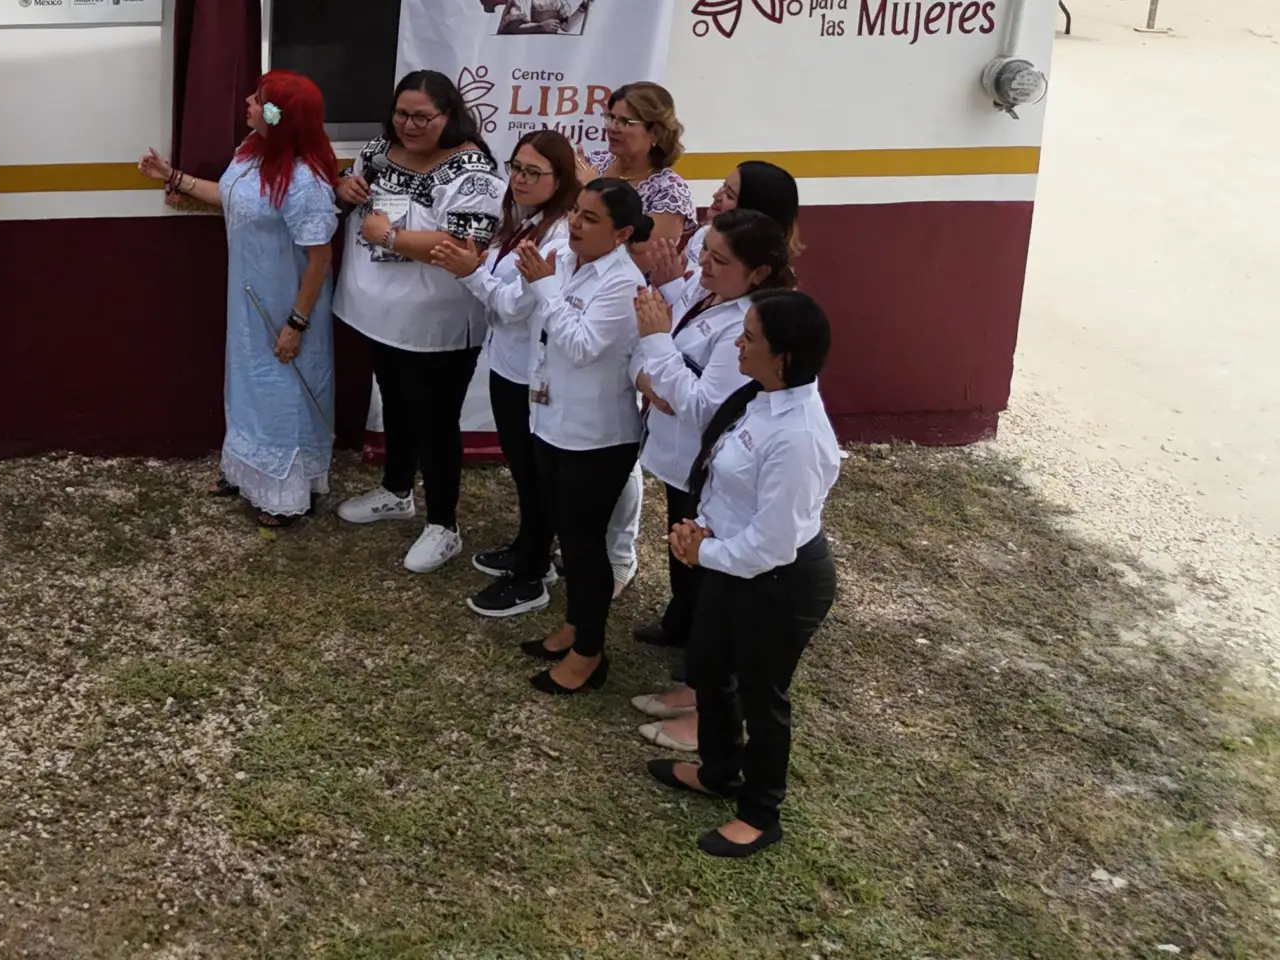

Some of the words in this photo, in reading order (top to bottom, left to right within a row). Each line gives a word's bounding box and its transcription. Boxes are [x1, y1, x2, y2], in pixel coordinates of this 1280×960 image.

[820, 14, 845, 36] las
[511, 68, 564, 82] Centro
[508, 84, 613, 116] LIBR
[508, 121, 536, 131] para
